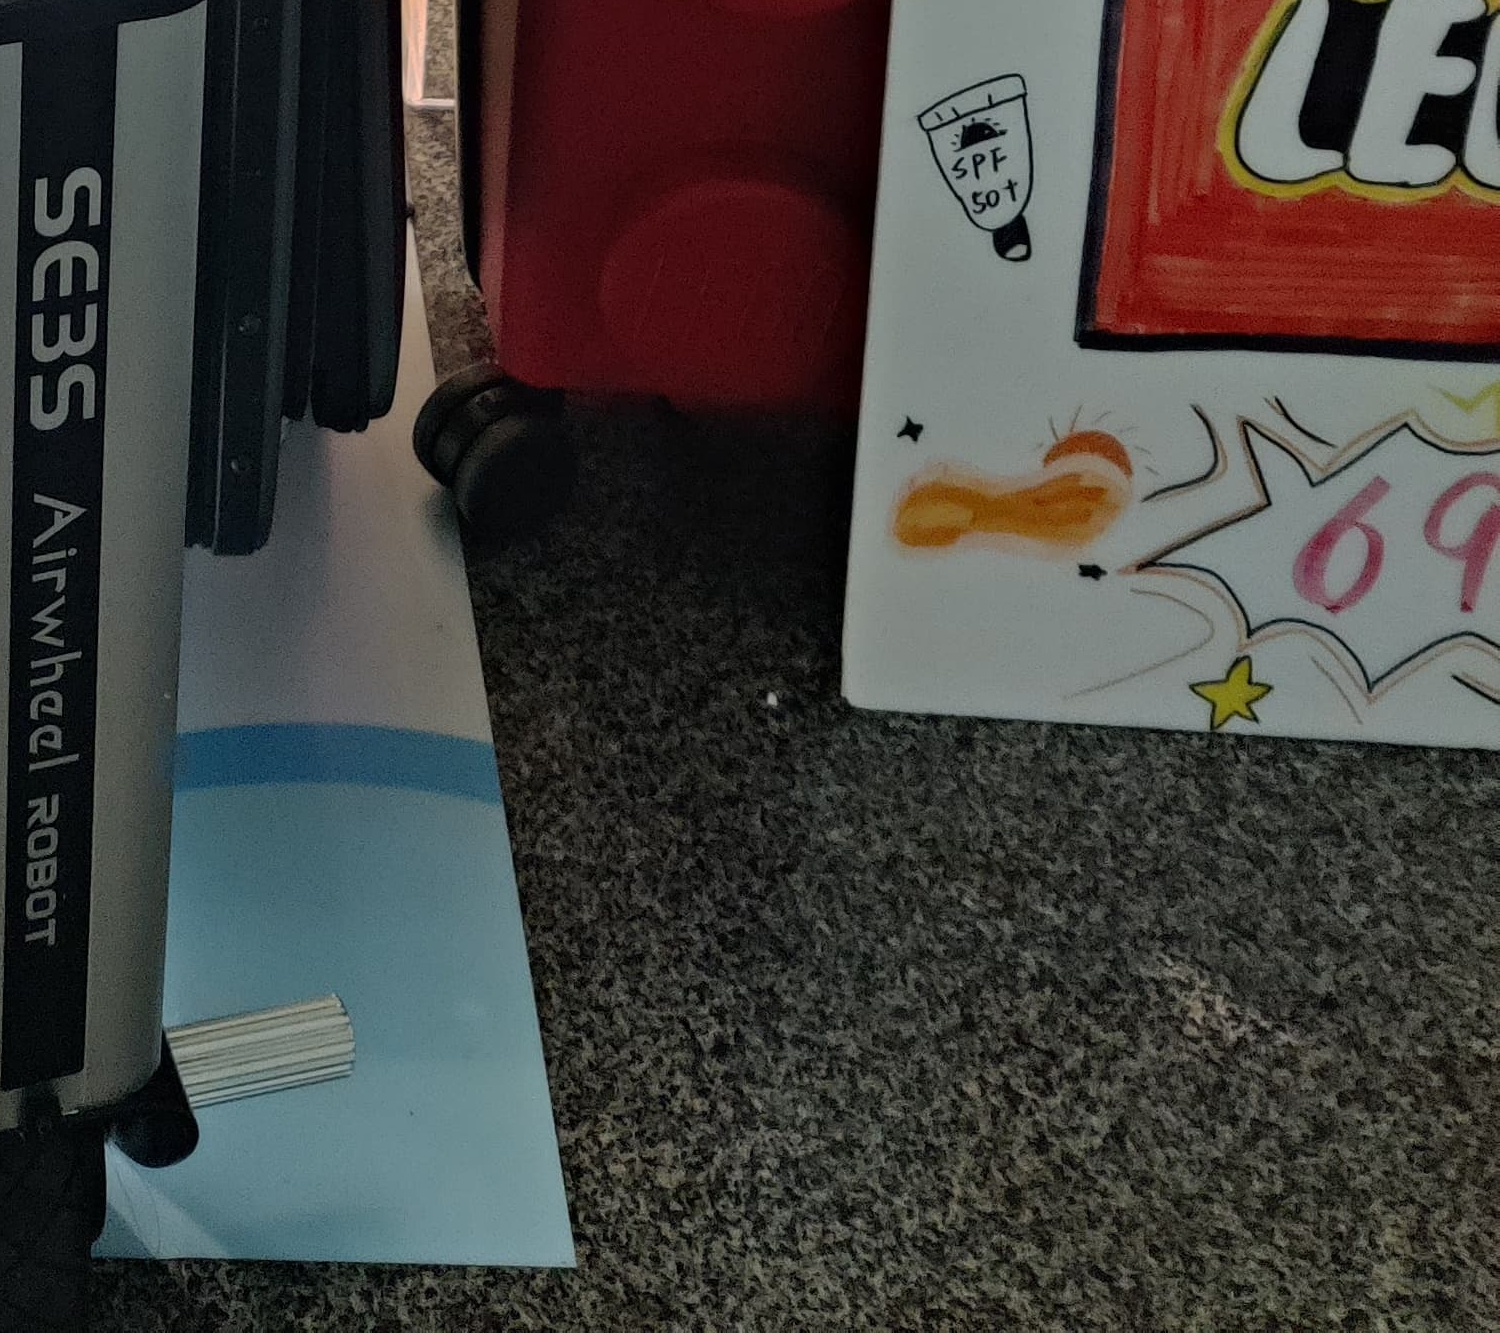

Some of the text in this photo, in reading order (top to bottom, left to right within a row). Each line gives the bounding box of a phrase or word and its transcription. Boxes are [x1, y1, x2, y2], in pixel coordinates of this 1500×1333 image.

[951, 148, 1009, 180] SPF
[971, 178, 1019, 214] 50+
[26, 492, 89, 774] Airwheel
[22, 792, 60, 947] ROBOT
